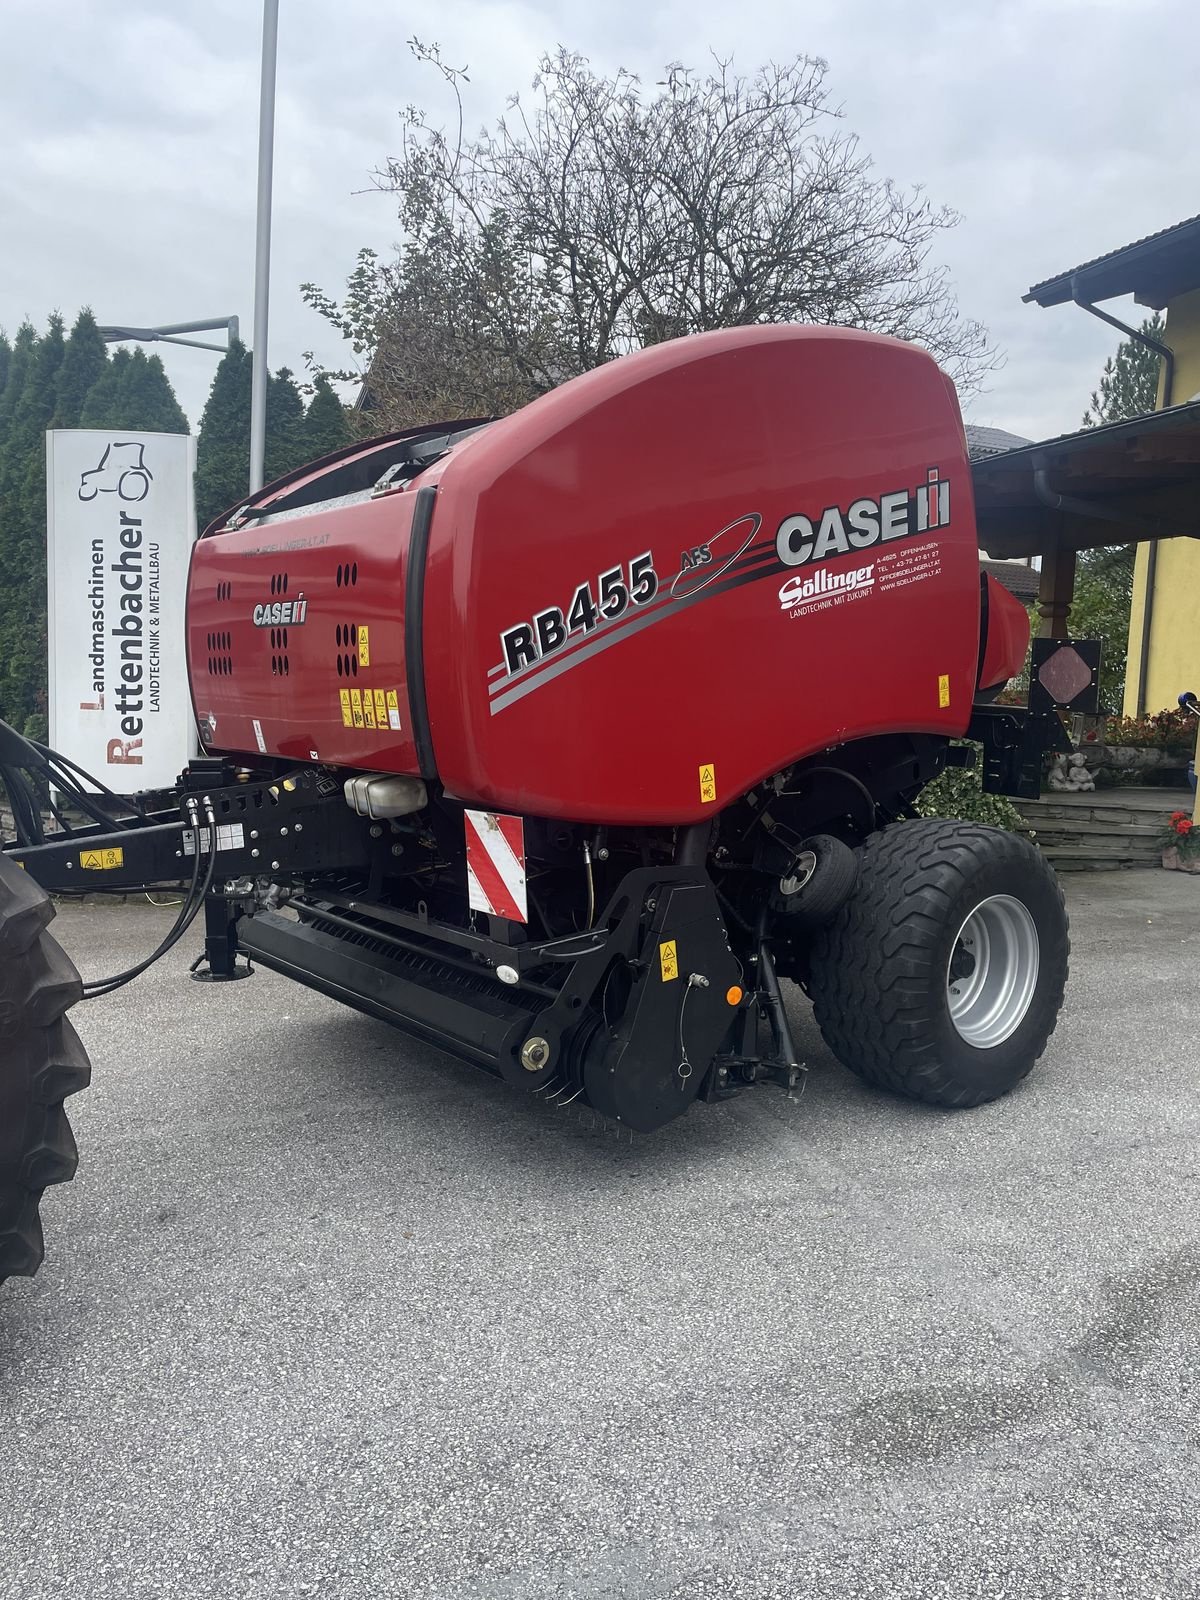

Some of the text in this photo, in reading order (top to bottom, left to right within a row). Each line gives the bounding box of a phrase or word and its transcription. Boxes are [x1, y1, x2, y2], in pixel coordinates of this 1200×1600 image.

[680, 543, 713, 571] AFS
[776, 490, 909, 566] CASE
[80, 538, 104, 711] Landmaschinen
[253, 602, 292, 626] CASE
[500, 550, 659, 679] RB455
[778, 563, 875, 610] Söllinger
[789, 586, 873, 619] LANDTECHNIK MIT ZUKUNFT
[107, 511, 143, 765] Rettenbacher
[150, 542, 160, 713] LANDTECHNIK & METALLBAU
